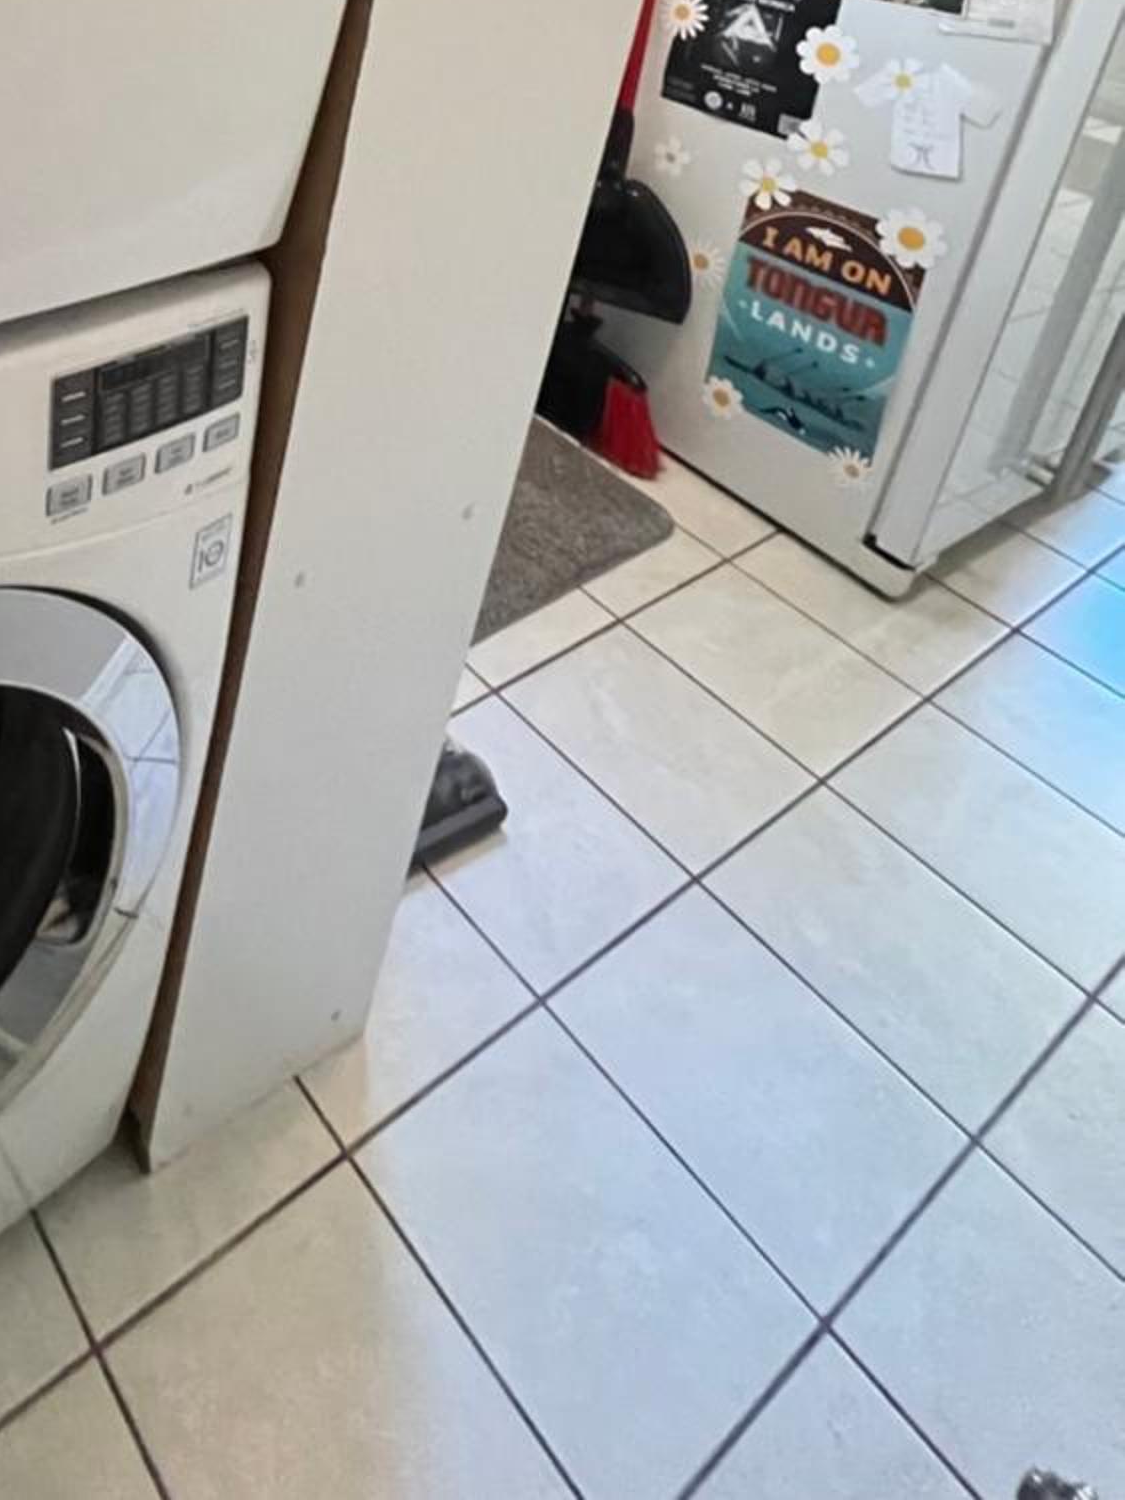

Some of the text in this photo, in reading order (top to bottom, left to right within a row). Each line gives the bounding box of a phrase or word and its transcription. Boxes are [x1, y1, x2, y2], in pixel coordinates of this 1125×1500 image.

[763, 226, 892, 295] I AM ON
[751, 301, 860, 364] LANDS
